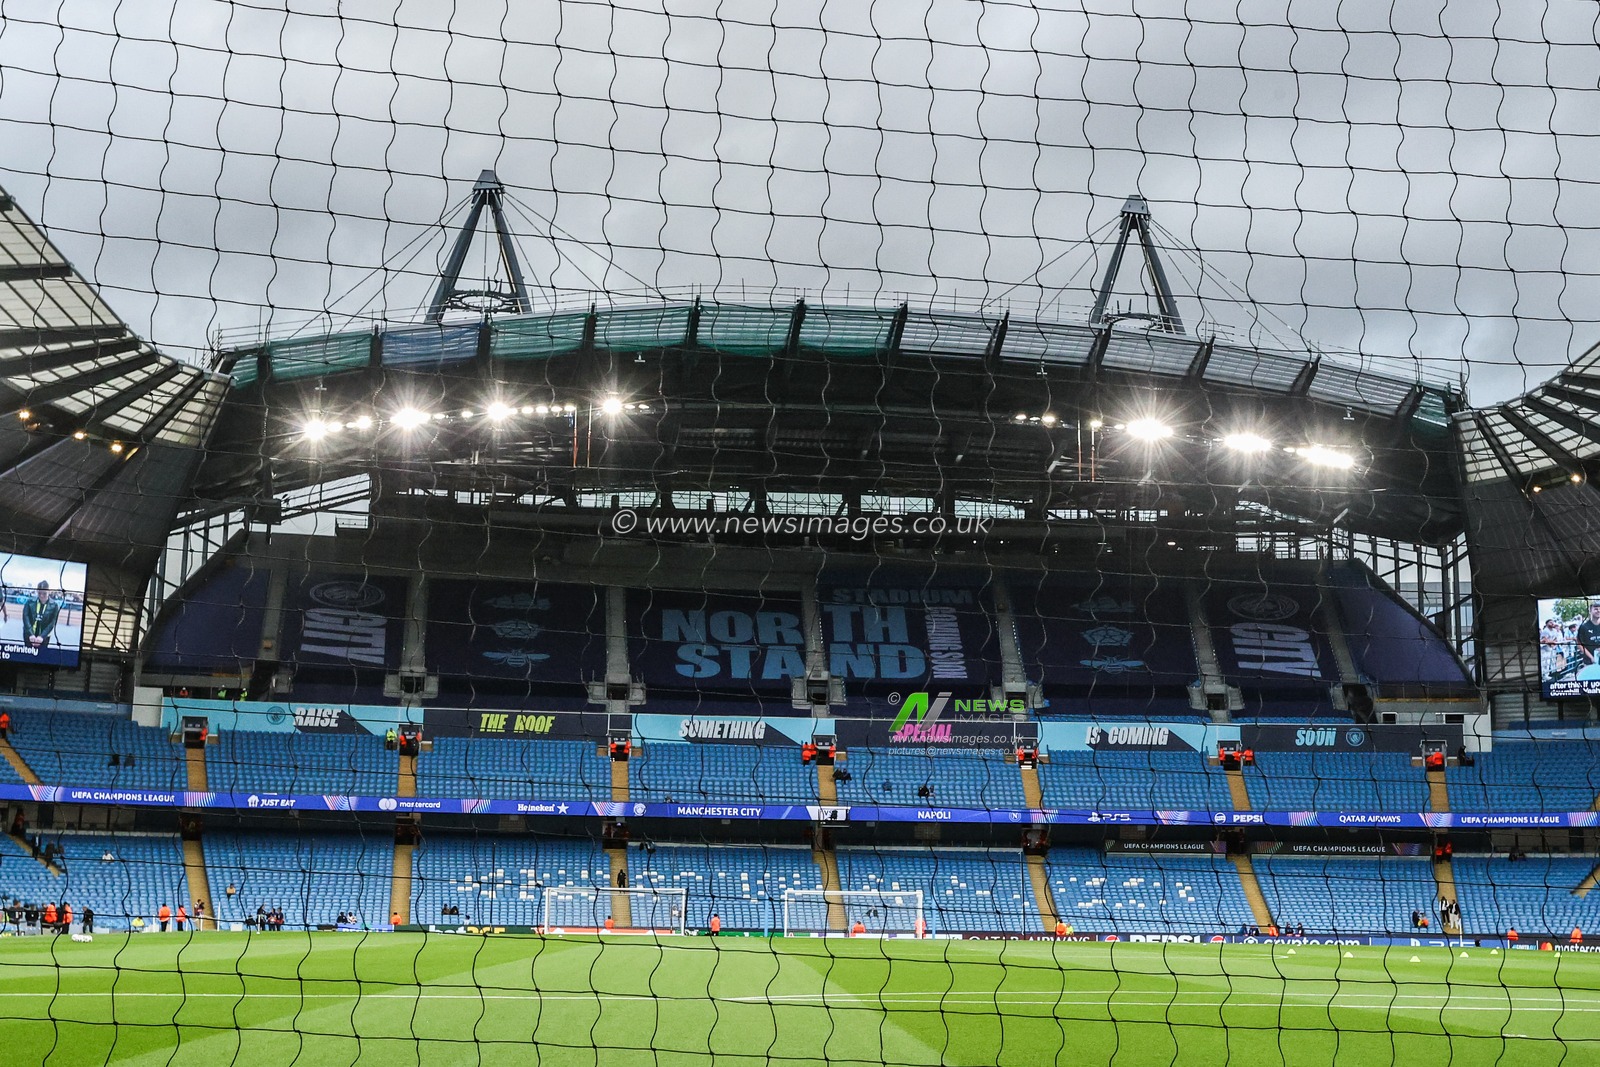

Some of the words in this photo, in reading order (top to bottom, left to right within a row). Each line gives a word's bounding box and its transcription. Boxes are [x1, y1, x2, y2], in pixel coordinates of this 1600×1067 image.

[832, 588, 973, 604] STADIUM
[293, 707, 342, 728] RAISE
[480, 713, 509, 733] THE
[513, 714, 556, 735] ROOF
[678, 719, 766, 739] SOMETHING
[1085, 726, 1102, 744] IS
[1107, 726, 1169, 745] COMING
[1295, 727, 1337, 746] SOON
[71, 791, 92, 800] UEFA
[94, 792, 143, 802] CHAMPIONS
[260, 799, 279, 807] JUST
[280, 799, 296, 807] EAT
[517, 803, 555, 812] Heineken
[677, 807, 739, 816] MANCHESTER
[740, 808, 762, 817] CITY
[917, 811, 951, 820] NAPOLI
[1232, 814, 1264, 823] PEPSI
[1338, 815, 1366, 824] QATAR
[1367, 815, 1402, 823] AIRWAYS
[1461, 816, 1481, 824] UEFA
[1482, 816, 1529, 824] CHAMPIONS
[1529, 816, 1560, 824] LEAGUE
